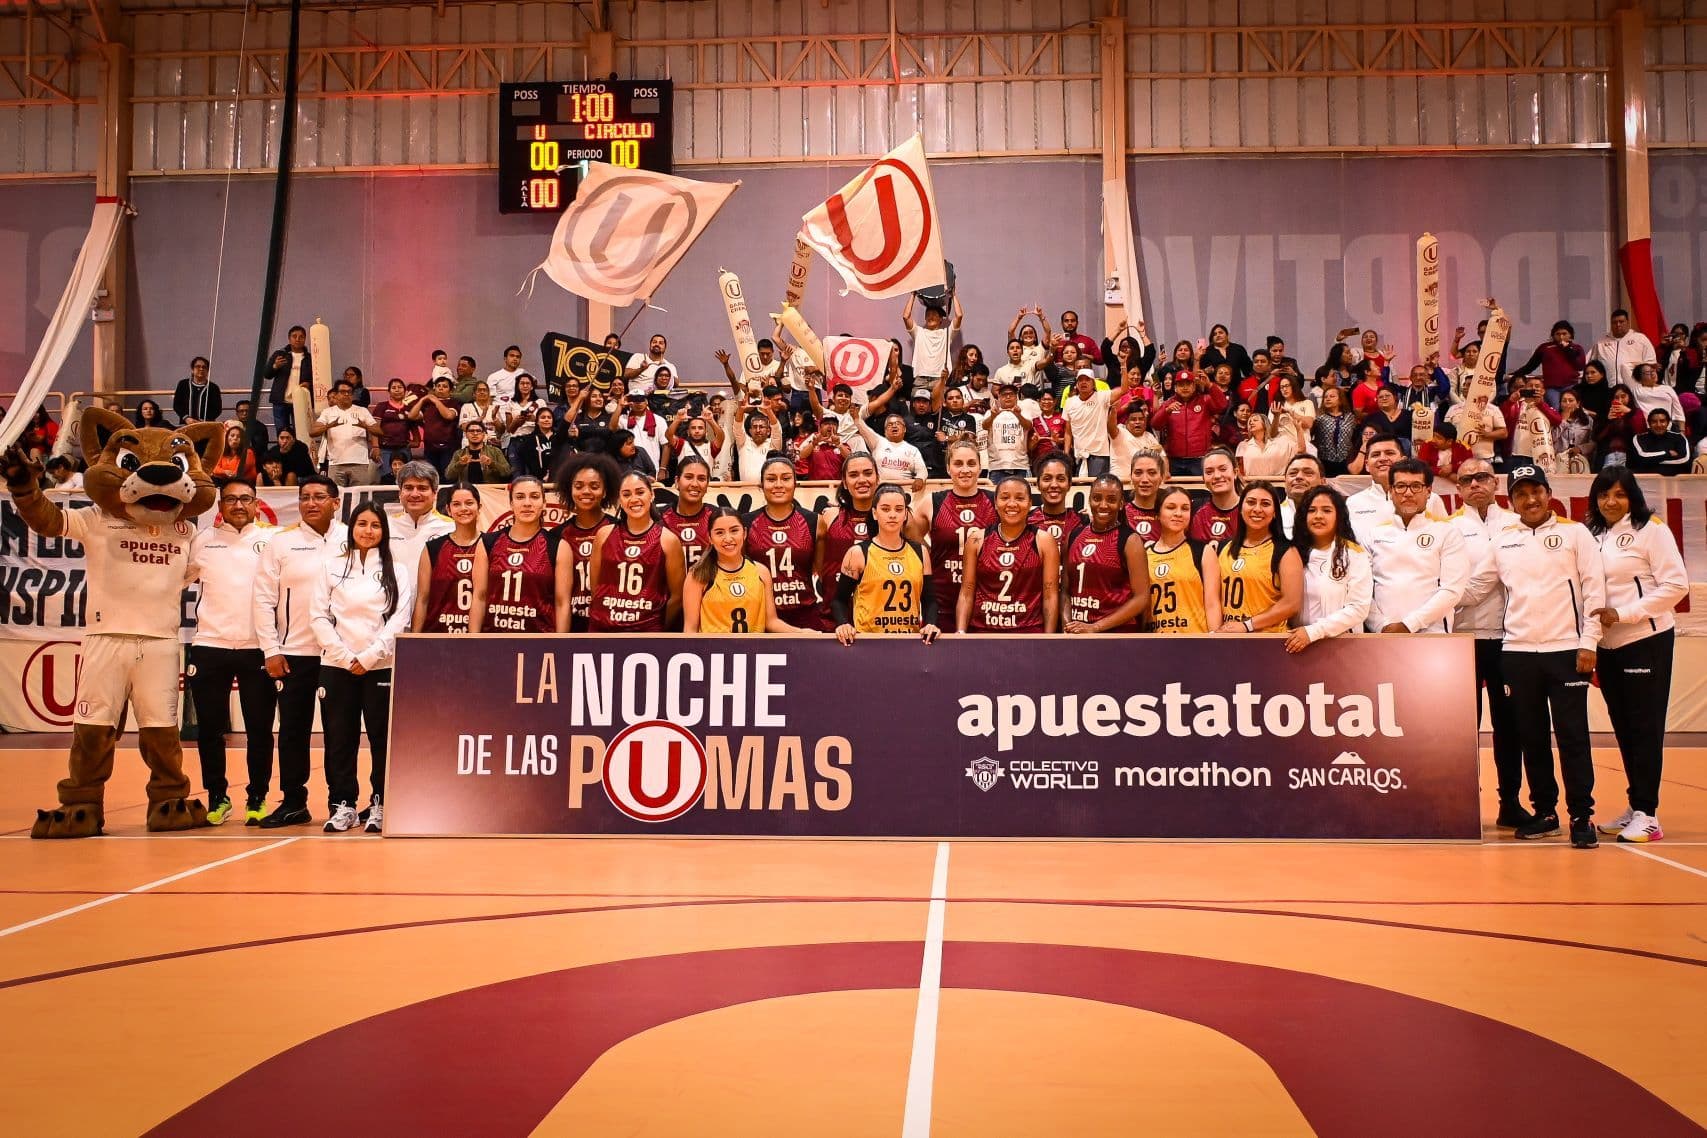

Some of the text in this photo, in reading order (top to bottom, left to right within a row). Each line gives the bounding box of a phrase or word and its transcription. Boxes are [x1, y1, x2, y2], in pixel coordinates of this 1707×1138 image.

[514, 90, 538, 100] POSS
[563, 84, 606, 94] TIEMPO
[634, 88, 658, 98] POSS
[571, 93, 614, 122] 1:00
[535, 123, 652, 140] U CIRCOLO
[530, 142, 559, 171] 00
[567, 149, 603, 159] PERIODO
[611, 140, 639, 169] 00
[530, 179, 559, 208] 00
[554, 339, 622, 390] 100
[1512, 467, 1536, 479] 100
[120, 540, 181, 555] apuesta
[132, 551, 170, 565] total
[765, 547, 795, 578] 14
[501, 570, 523, 602] 11
[617, 562, 643, 595] 16
[774, 579, 806, 591] uesta
[998, 570, 1013, 602] 2
[1076, 562, 1086, 594] 1
[457, 578, 473, 610] 6
[775, 593, 801, 606] otal
[882, 580, 912, 612] 23
[1151, 581, 1177, 616] 25
[1223, 576, 1244, 610] 10
[488, 604, 537, 618] apuesta
[602, 596, 652, 611] apuesta
[981, 601, 1027, 614] apuesta
[439, 613, 470, 626] apue
[494, 615, 525, 631] total
[609, 608, 640, 622] total
[874, 615, 920, 627] apuesta
[985, 613, 1017, 627] total
[515, 652, 787, 727] LA NOCHE
[957, 682, 1404, 752] apuestatotal
[457, 734, 852, 811] DE LAS PUMAS
[1010, 760, 1098, 771] COLECTIVO
[1010, 773, 1099, 789] WORLD
[1115, 762, 1271, 787] marathon
[1288, 768, 1326, 789] SAN
